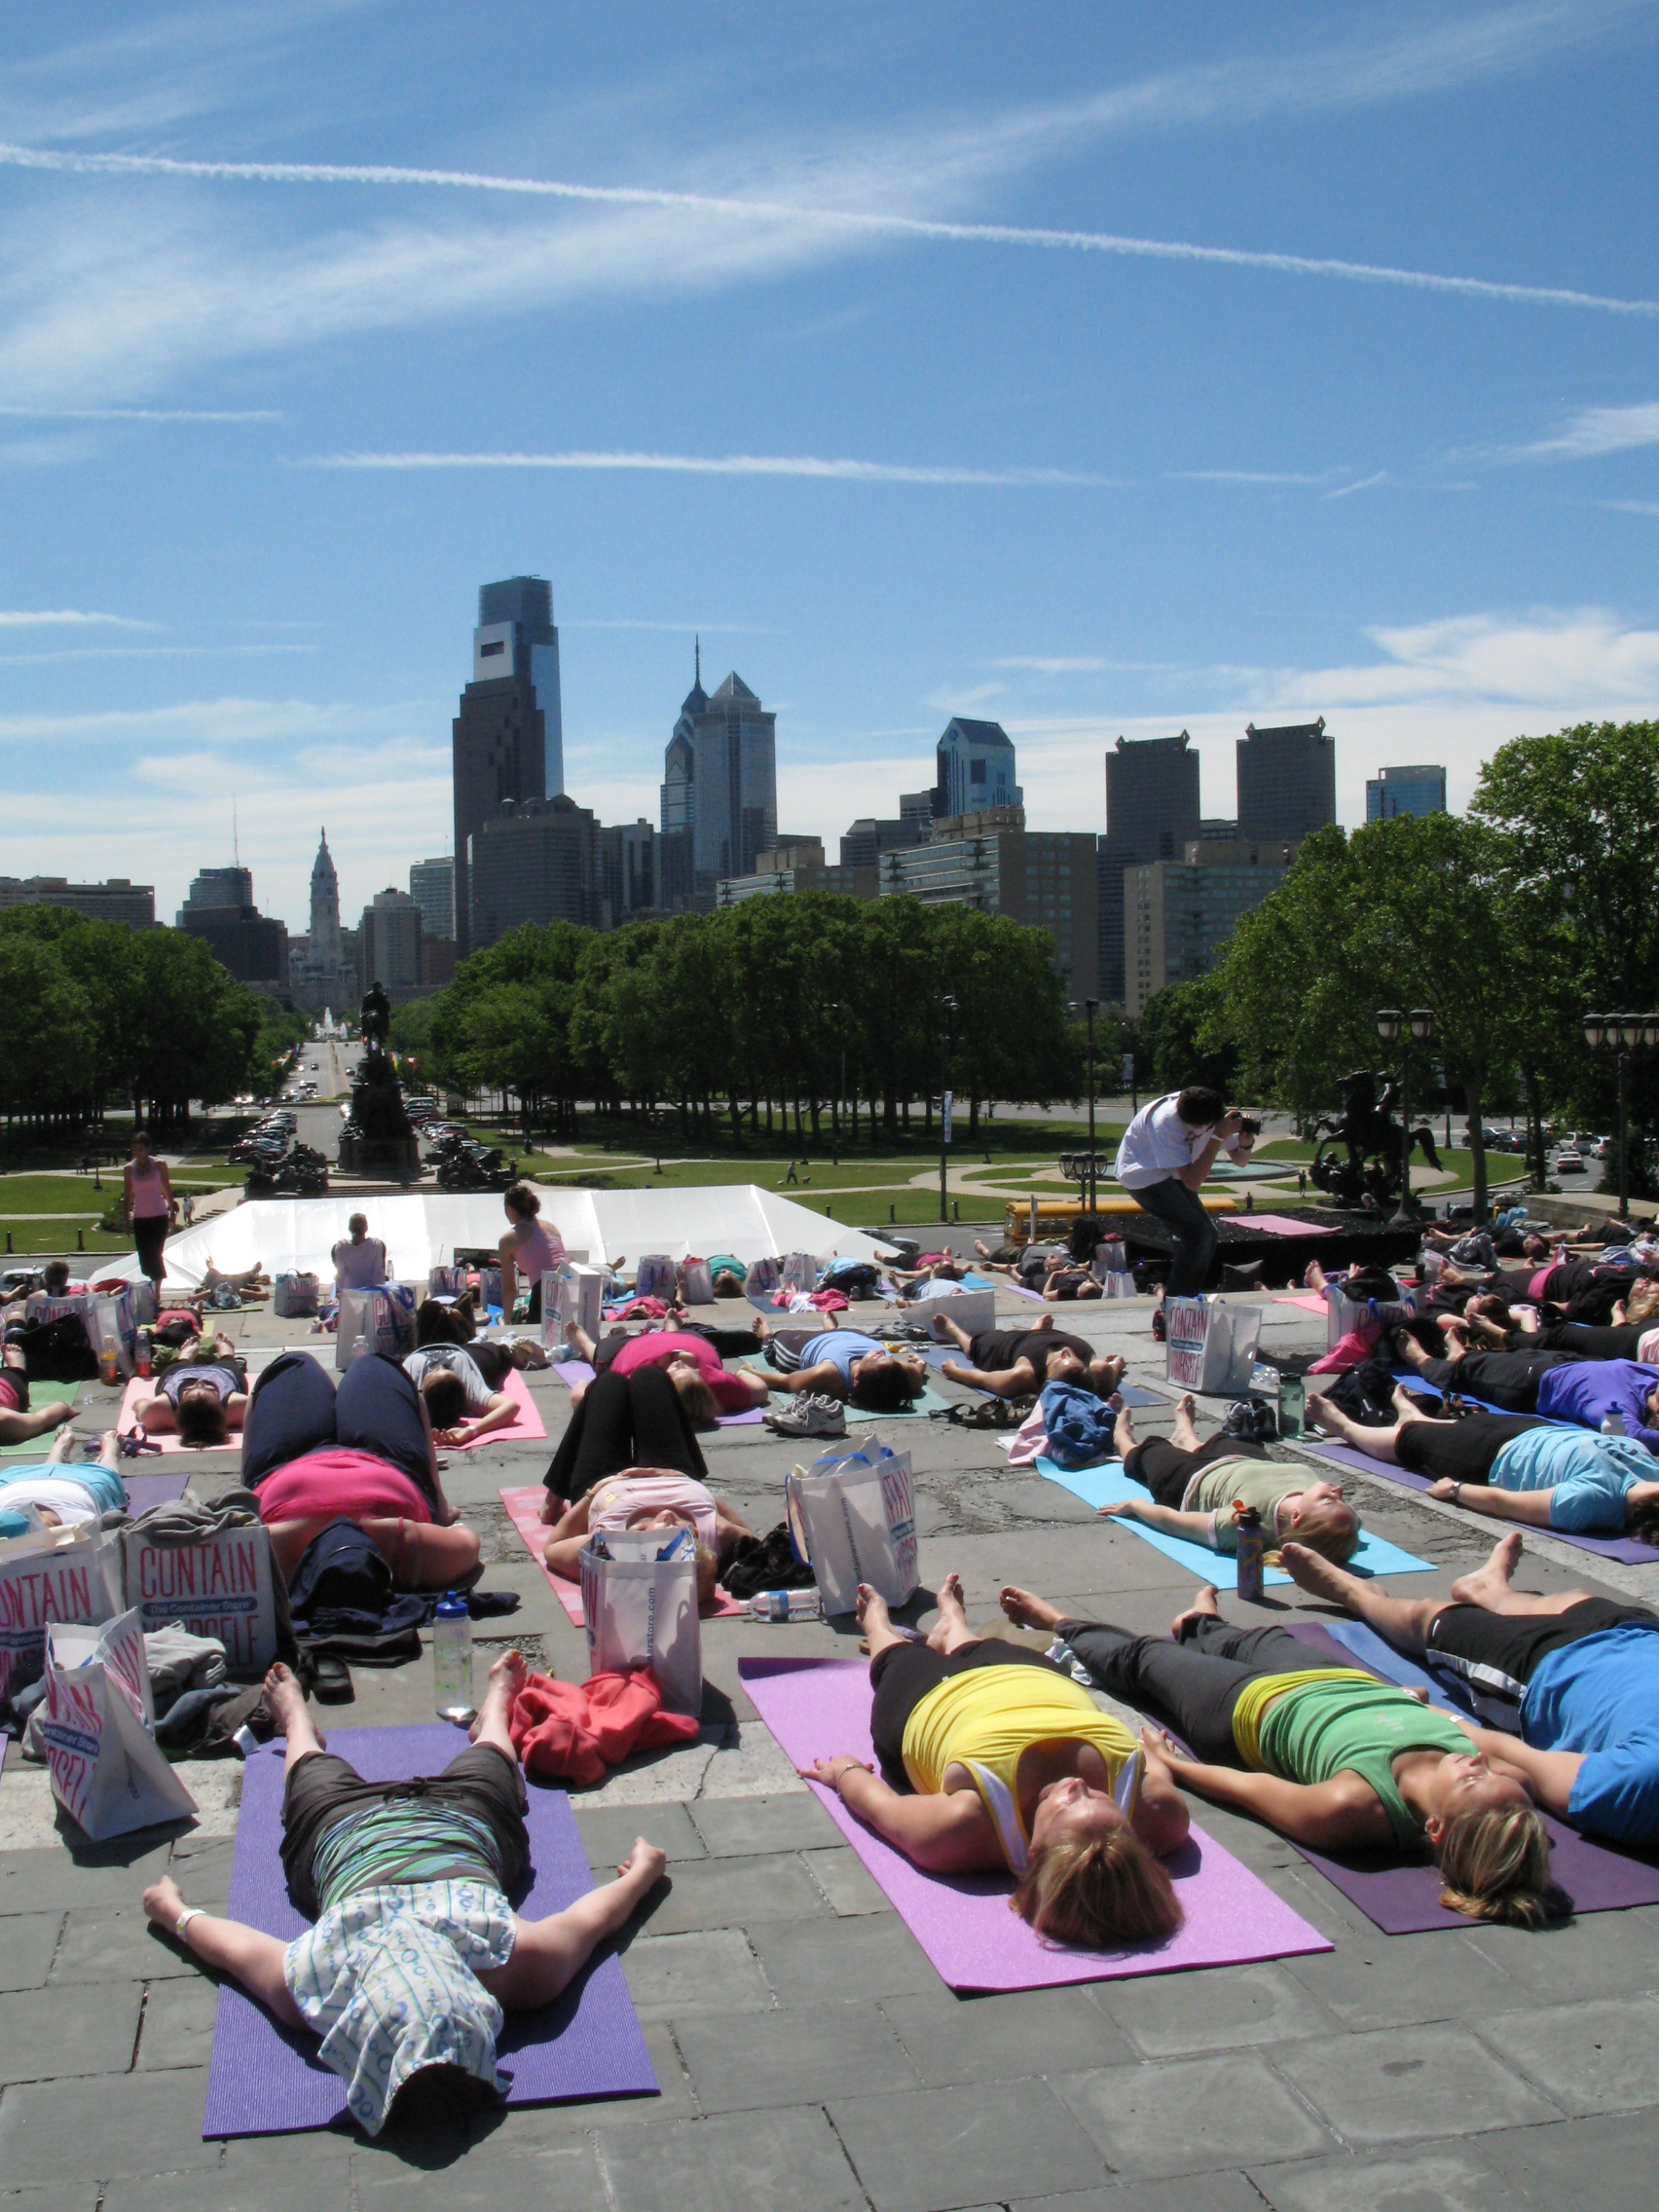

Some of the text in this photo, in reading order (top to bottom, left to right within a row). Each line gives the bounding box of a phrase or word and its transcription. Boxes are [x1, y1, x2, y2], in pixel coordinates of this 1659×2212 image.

[1170, 1307, 1208, 1341] CONTAIN
[139, 1541, 258, 1599] CONTAIN
[169, 1602, 221, 1613] Container
